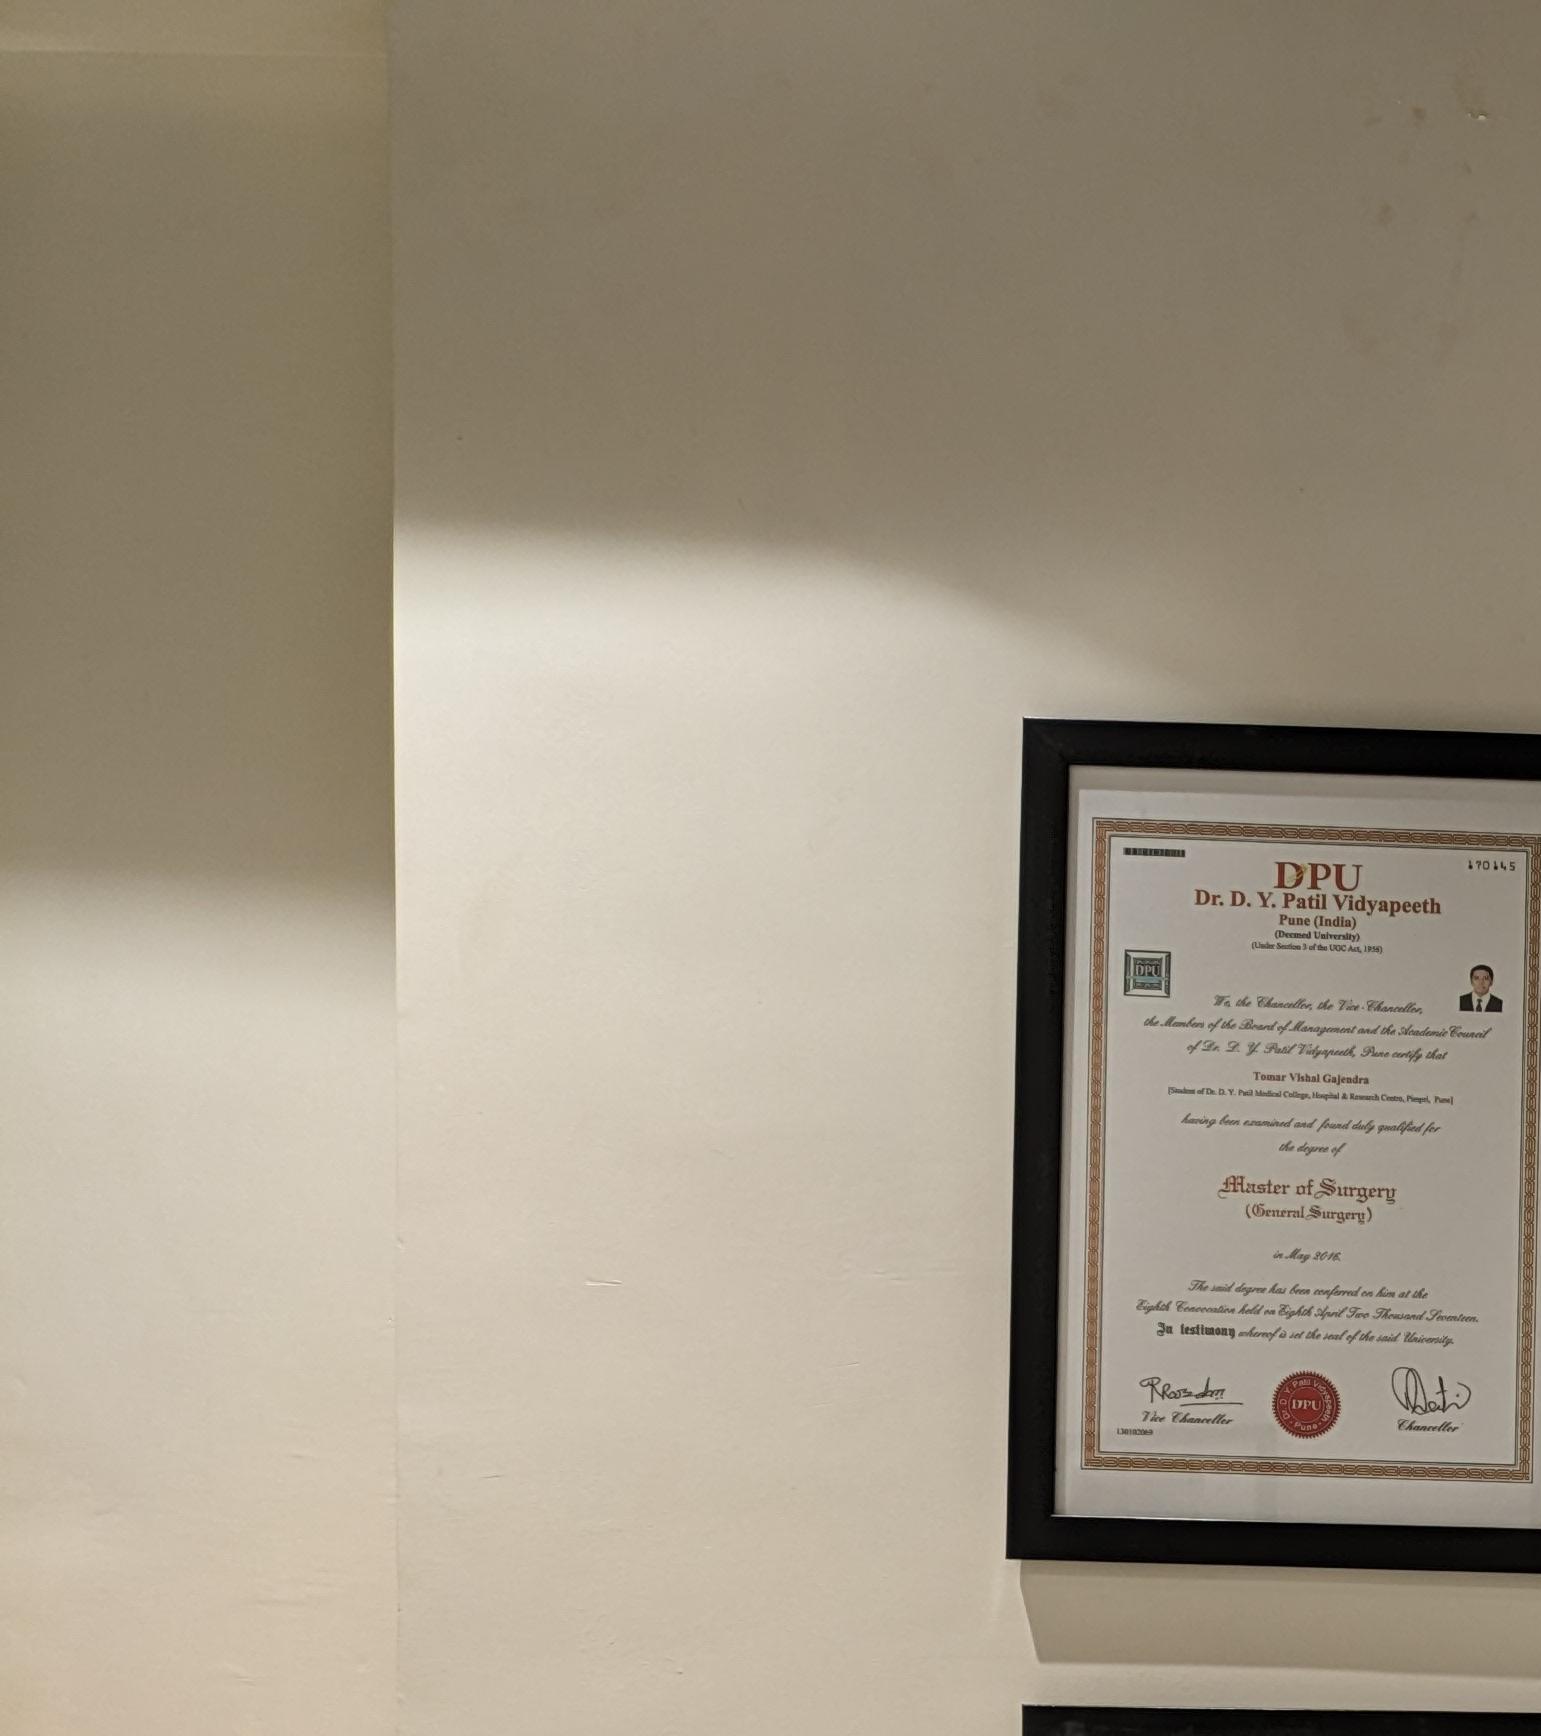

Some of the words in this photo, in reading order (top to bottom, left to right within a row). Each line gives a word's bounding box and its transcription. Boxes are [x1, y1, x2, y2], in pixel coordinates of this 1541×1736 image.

[1274, 861, 1363, 892] DPU
[1194, 889, 1224, 906] Dr.
[1230, 890, 1251, 907] D.
[1257, 892, 1276, 908] Y.
[1282, 893, 1327, 910] Patil
[1333, 894, 1441, 916] Vidyapeeth
[1279, 914, 1311, 926] Pune
[1313, 915, 1357, 930] (India)
[1274, 930, 1311, 940] (Deemed
[1314, 932, 1360, 942] University)
[1236, 996, 1251, 1007] the
[1256, 996, 1313, 1011] Chancellor,
[1317, 999, 1333, 1011] the
[1144, 1016, 1159, 1027] the
[1208, 1018, 1222, 1032] of
[1221, 1018, 1237, 1030] the
[1288, 1020, 1357, 1036] Management
[1357, 1024, 1378, 1035] and
[1380, 1024, 1396, 1036] the
[1253, 1071, 1287, 1082] Tomar
[1289, 1072, 1320, 1083] Vishal
[1322, 1073, 1369, 1085] Gajendra
[1219, 1114, 1240, 1126] been
[1294, 1118, 1318, 1129] and
[1278, 1140, 1295, 1152] the
[1297, 1143, 1329, 1156] degree
[1331, 1142, 1347, 1157] of
[1218, 1175, 1290, 1199] Master
[1296, 1179, 1314, 1196] of
[1314, 1178, 1396, 1205] Surgery
[1245, 1203, 1305, 1220] (General
[1305, 1204, 1373, 1225] Surgery)
[1188, 1279, 1207, 1292] The
[1235, 1282, 1267, 1296] degree
[1268, 1283, 1286, 1295] has
[1289, 1284, 1310, 1295] been
[1376, 1287, 1396, 1298] him
[1412, 1288, 1428, 1300] the
[1180, 1324, 1236, 1339] testimony
[1305, 1328, 1321, 1340] the
[1359, 1330, 1374, 1342] the
[1292, 1400, 1321, 1410] DPU
[1142, 1410, 1166, 1423] Vice
[1172, 1411, 1233, 1425] Chancellor
[1397, 1418, 1460, 1433] Chancellor
